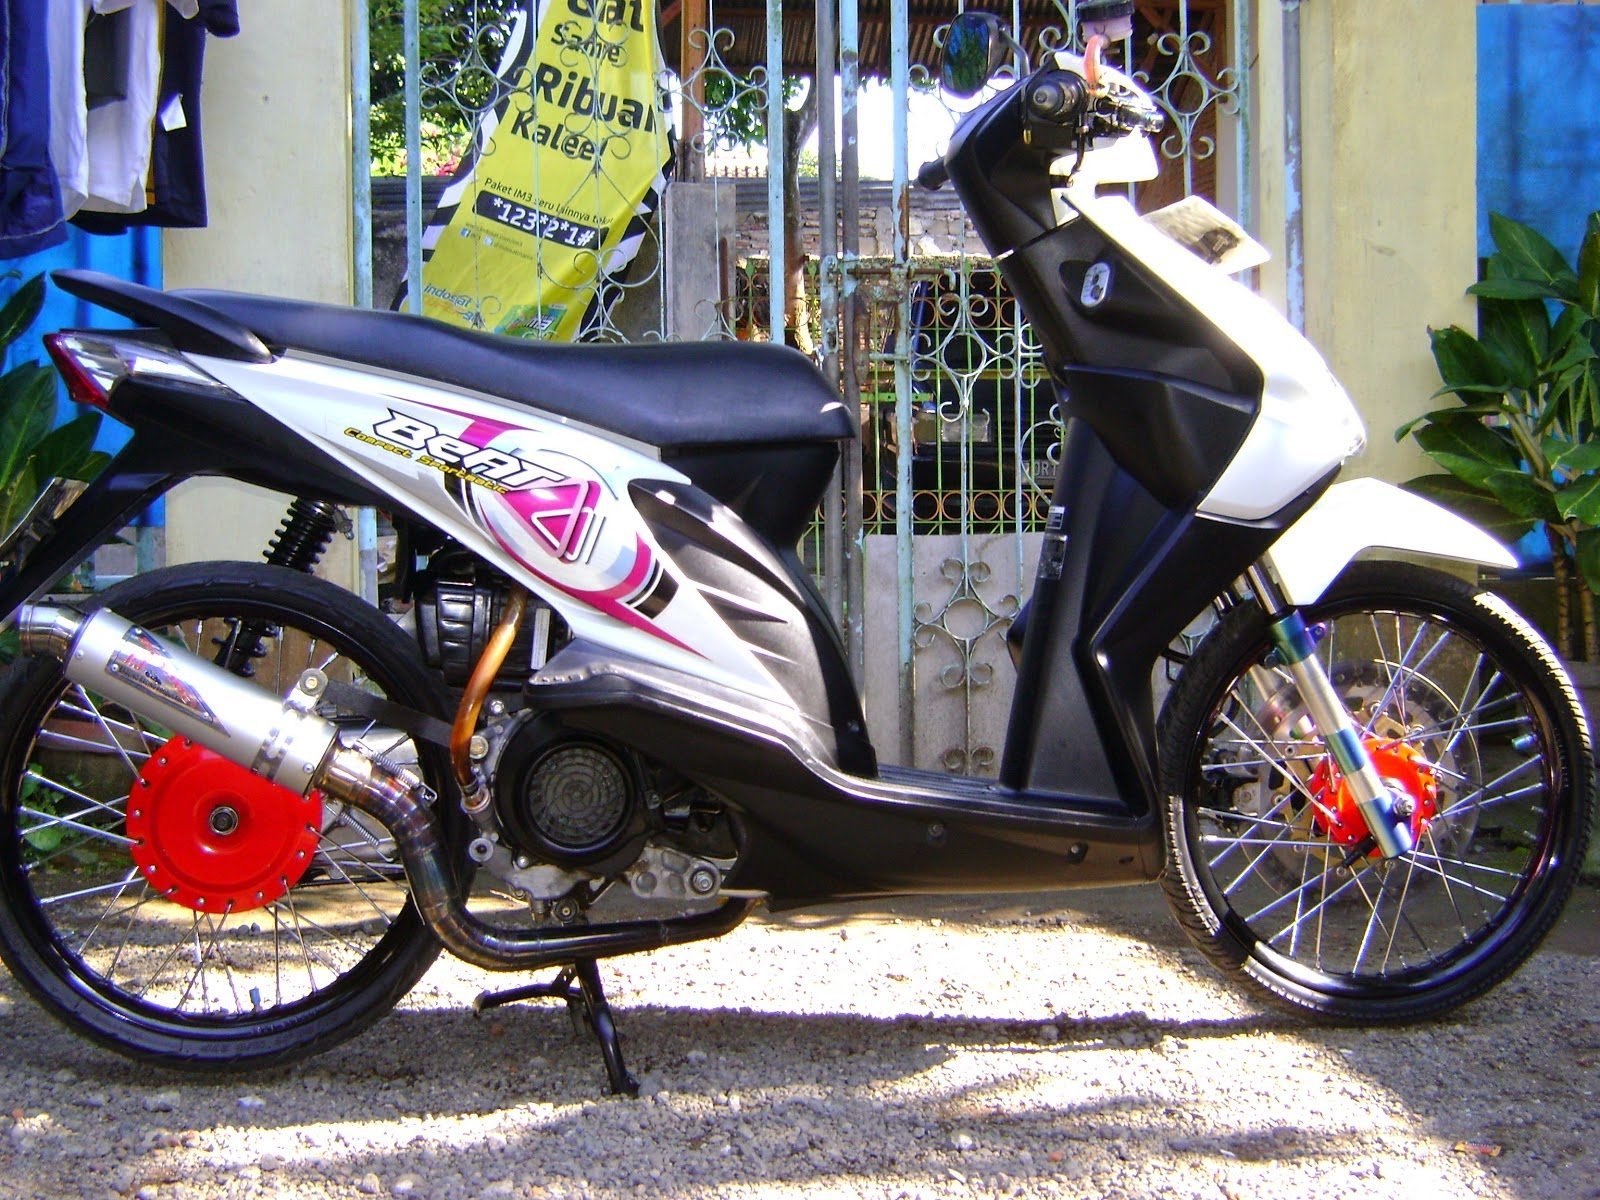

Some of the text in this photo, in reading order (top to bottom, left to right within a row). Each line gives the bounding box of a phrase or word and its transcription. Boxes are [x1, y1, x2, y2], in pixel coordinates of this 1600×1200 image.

[485, 177, 512, 196] Paket
[513, 188, 533, 202] IM3
[343, 427, 510, 495] Compact Sportmatic
